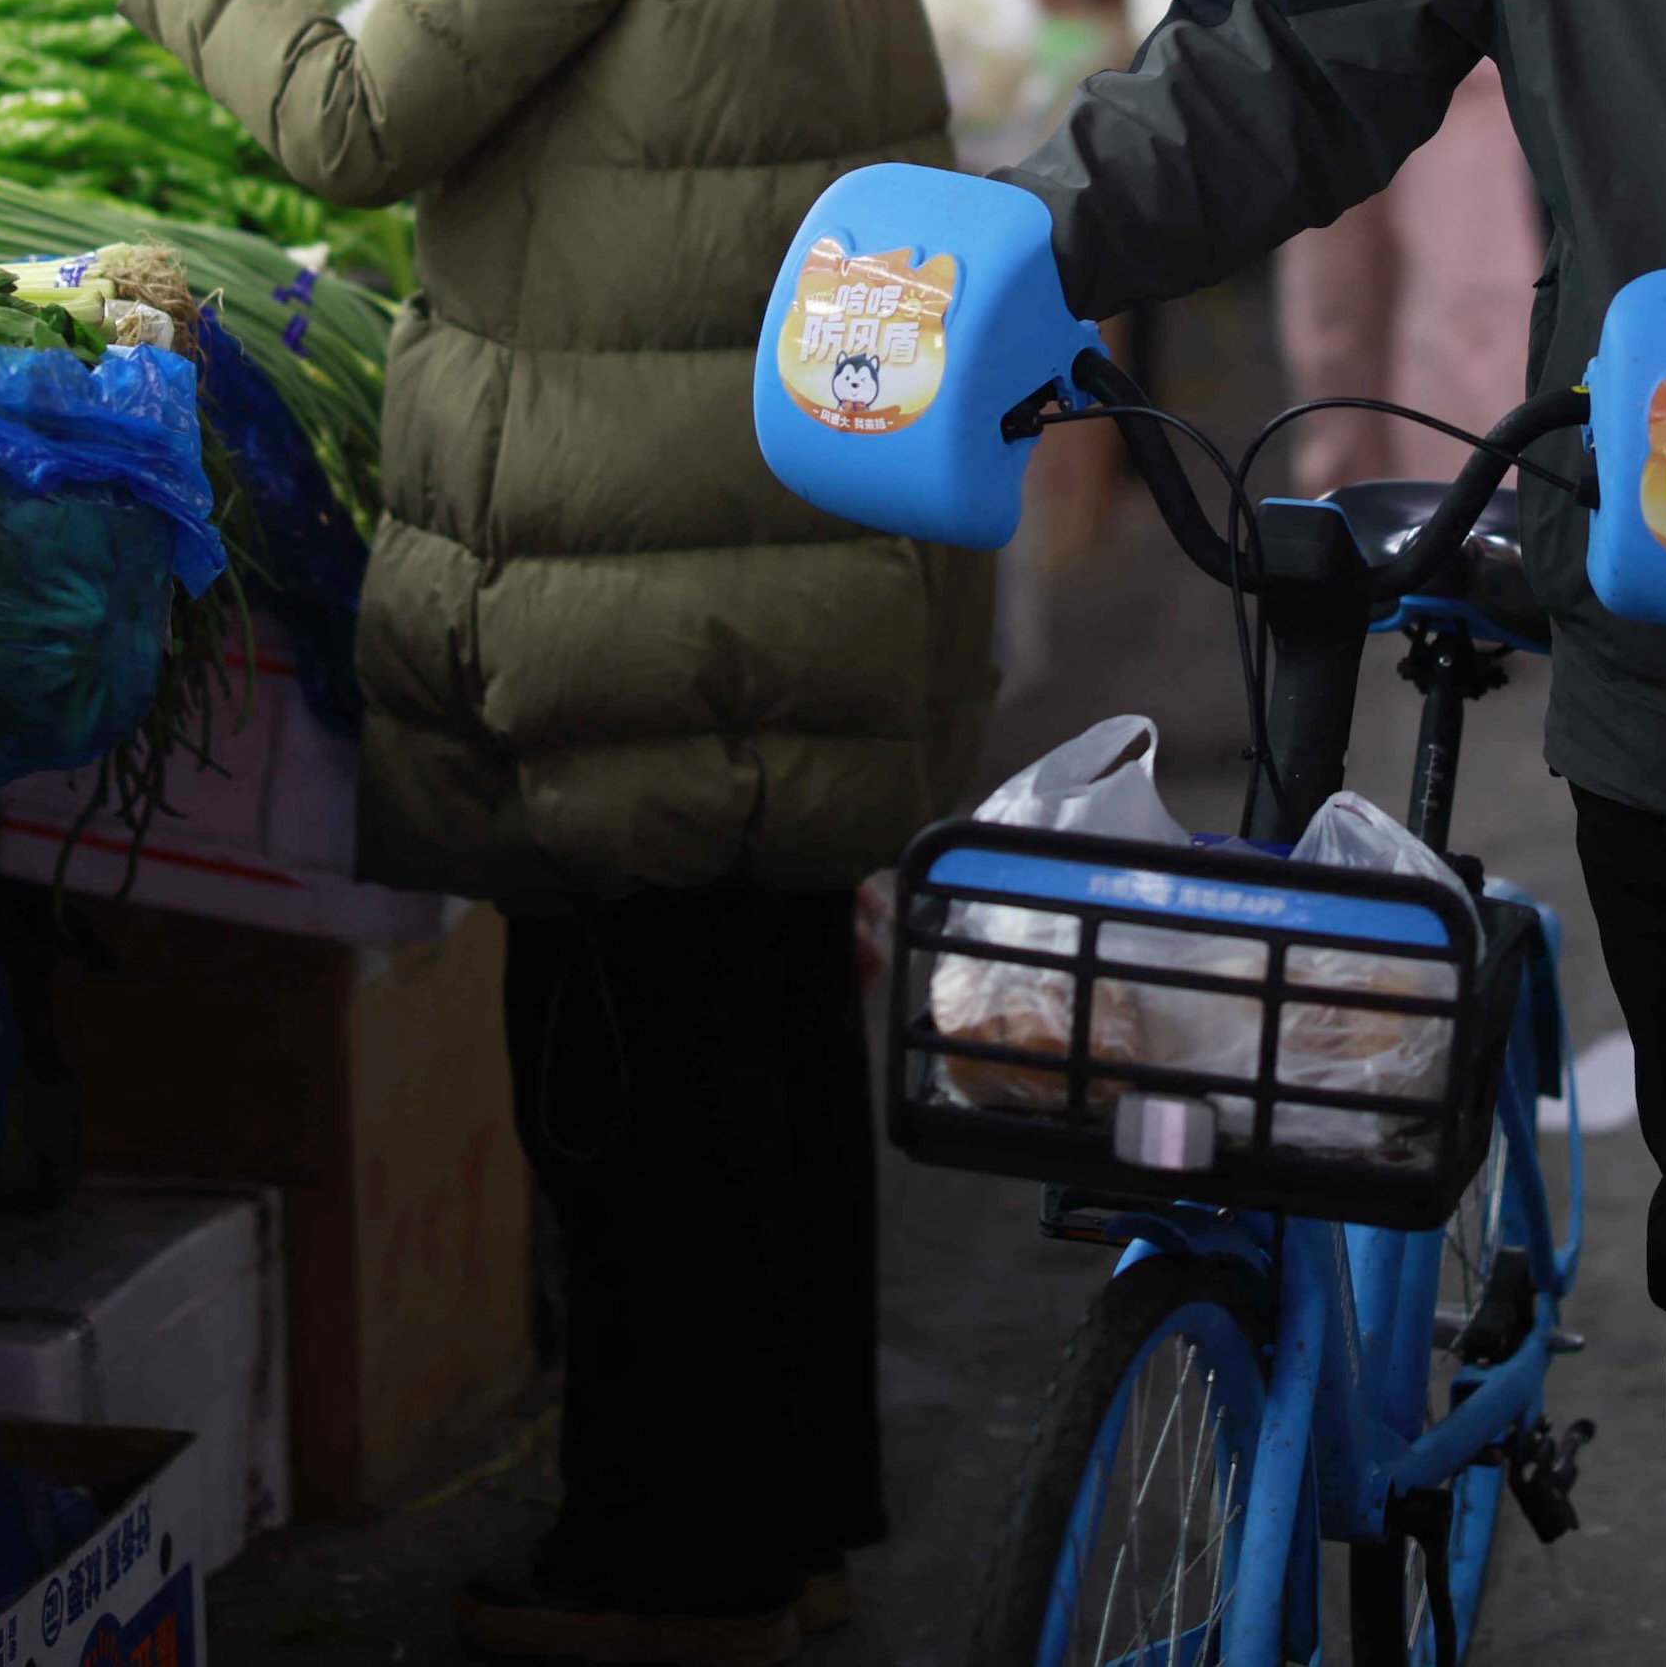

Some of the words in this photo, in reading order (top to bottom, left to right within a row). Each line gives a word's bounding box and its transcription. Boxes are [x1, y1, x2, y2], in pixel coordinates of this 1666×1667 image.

[835, 282, 903, 317] 哈啰
[799, 314, 920, 364] 防风盾
